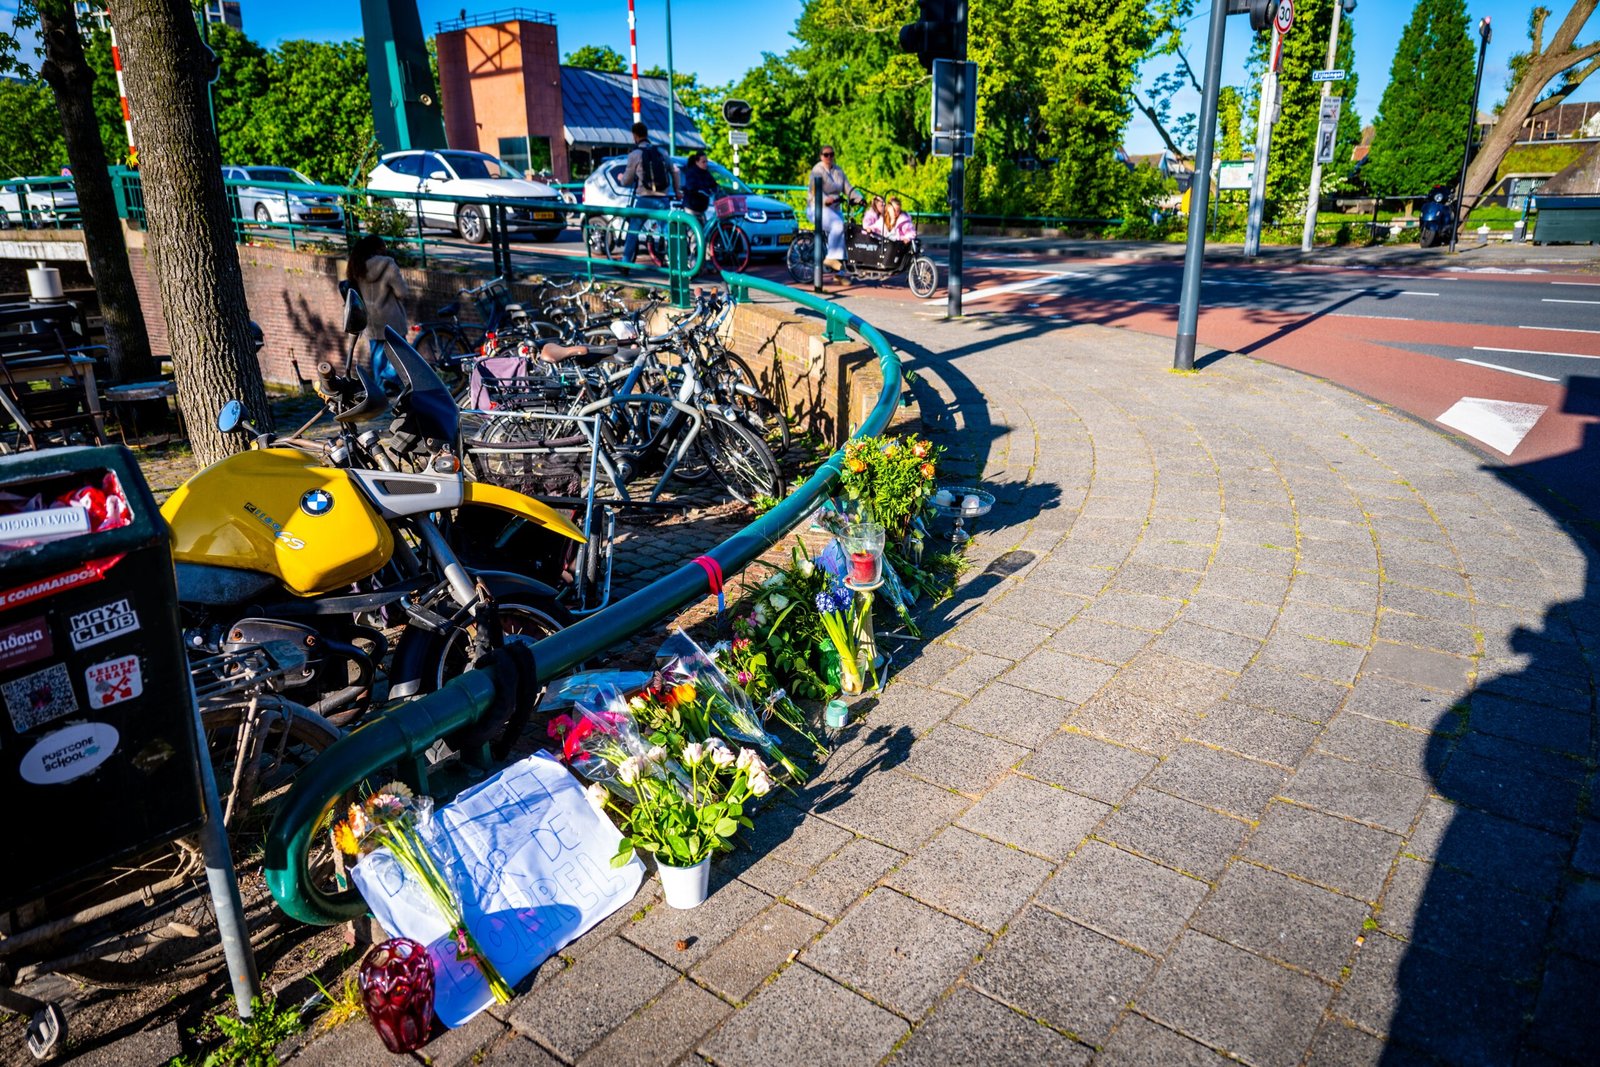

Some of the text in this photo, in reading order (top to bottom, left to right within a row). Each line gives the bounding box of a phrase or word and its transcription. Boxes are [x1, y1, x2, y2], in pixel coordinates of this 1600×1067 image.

[1279, 7, 1291, 22] 30
[274, 530, 305, 550] GS
[8, 569, 96, 602] COMMANDOS
[72, 602, 130, 630] MAXI
[74, 612, 136, 644] CLUB
[88, 659, 136, 679] LEIDEN
[42, 737, 95, 764] POSTCODE
[483, 766, 554, 826] HET
[531, 813, 582, 862] DE
[435, 852, 627, 994] BORREL
